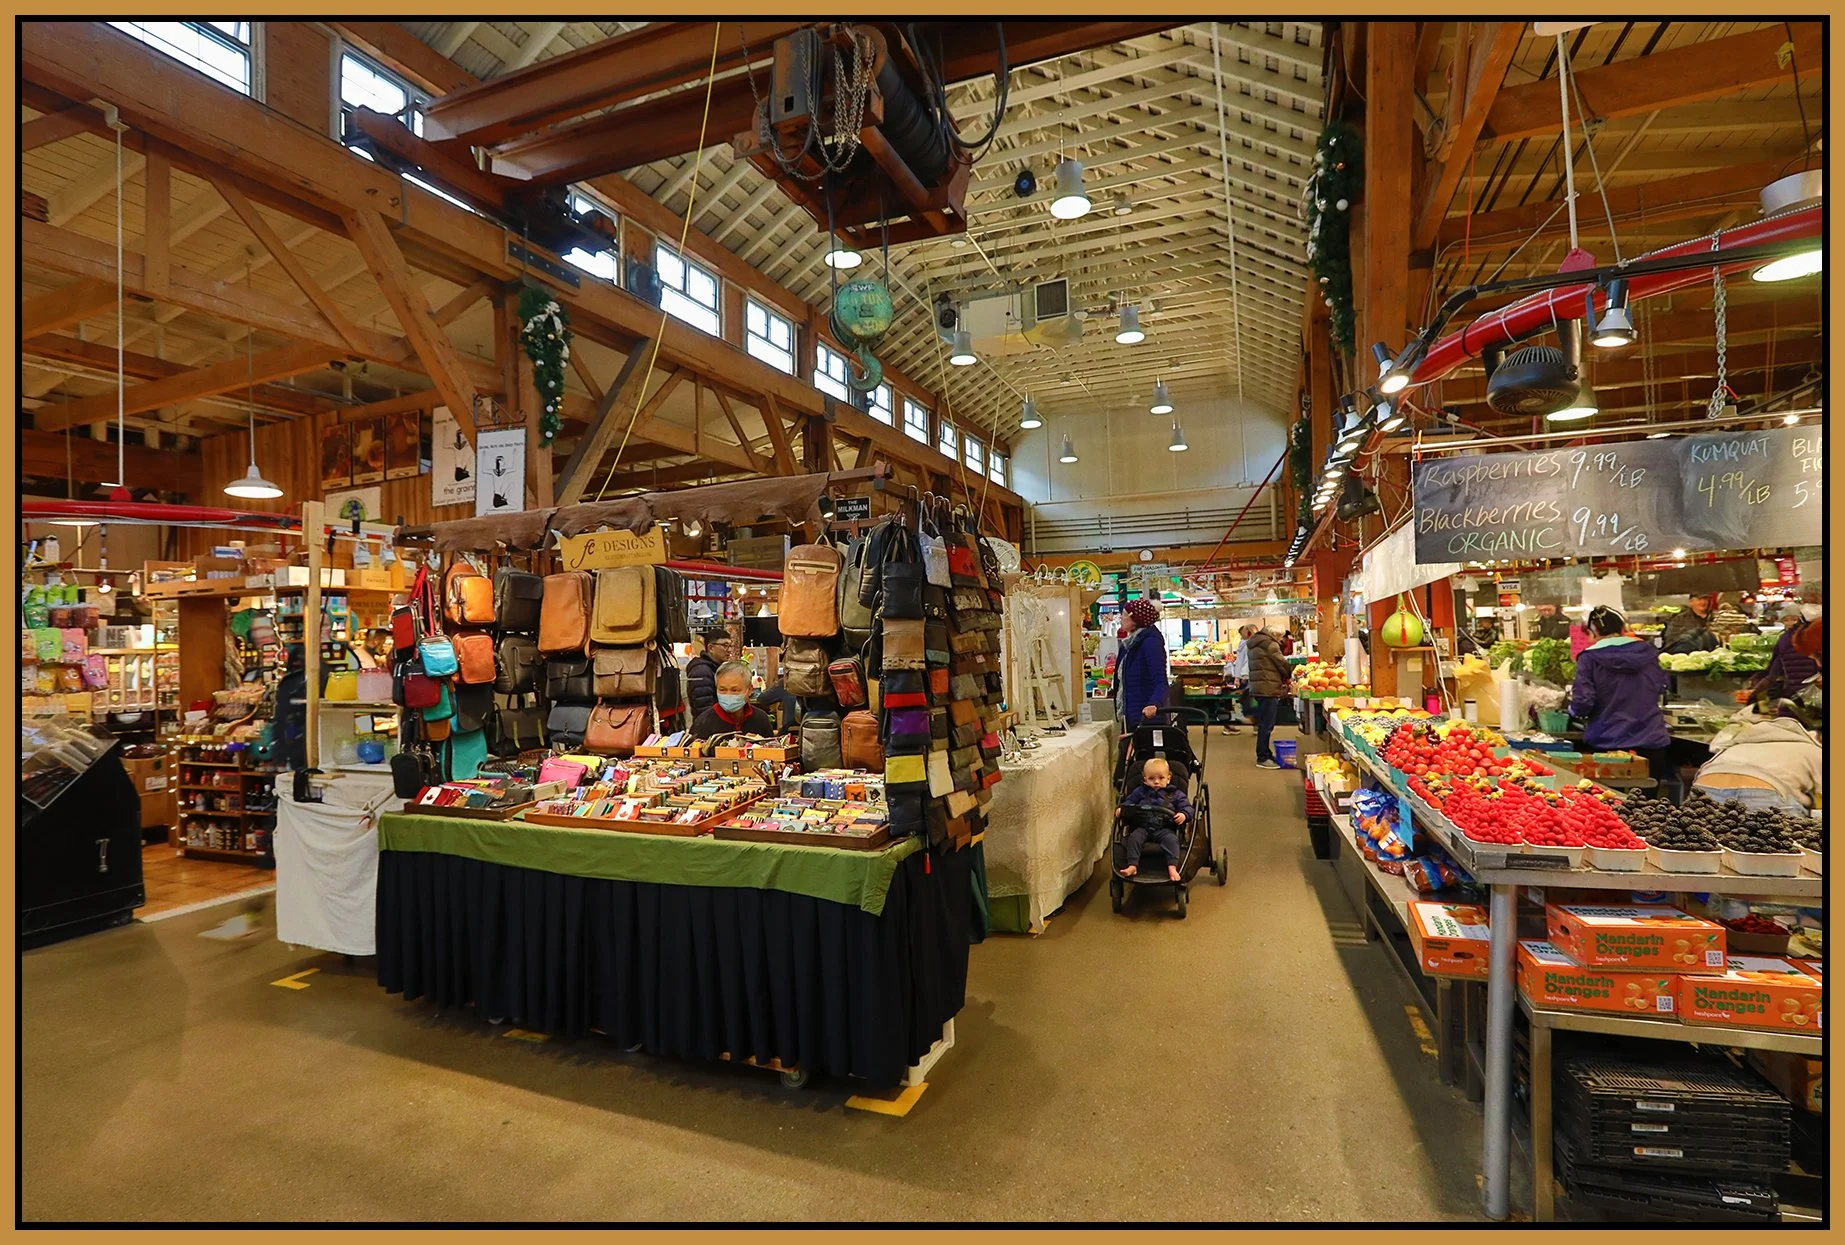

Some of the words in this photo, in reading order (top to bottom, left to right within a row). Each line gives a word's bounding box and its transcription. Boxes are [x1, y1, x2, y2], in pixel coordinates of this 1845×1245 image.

[1691, 437, 1771, 463] KUMQUAT
[1423, 450, 1562, 496] Raspberries
[837, 504, 868, 513] MILKMAN
[1419, 500, 1562, 535] Blackberries
[603, 536, 656, 553] DESIGNS
[1448, 527, 1562, 556] ORGANIC
[1595, 933, 1664, 945] Mandarin
[1596, 943, 1659, 957] Oranges
[1544, 972, 1614, 988] Mandarin
[1544, 982, 1609, 999] Oranges
[1695, 987, 1771, 1003] Mandarin
[1695, 998, 1765, 1014] Oranges
